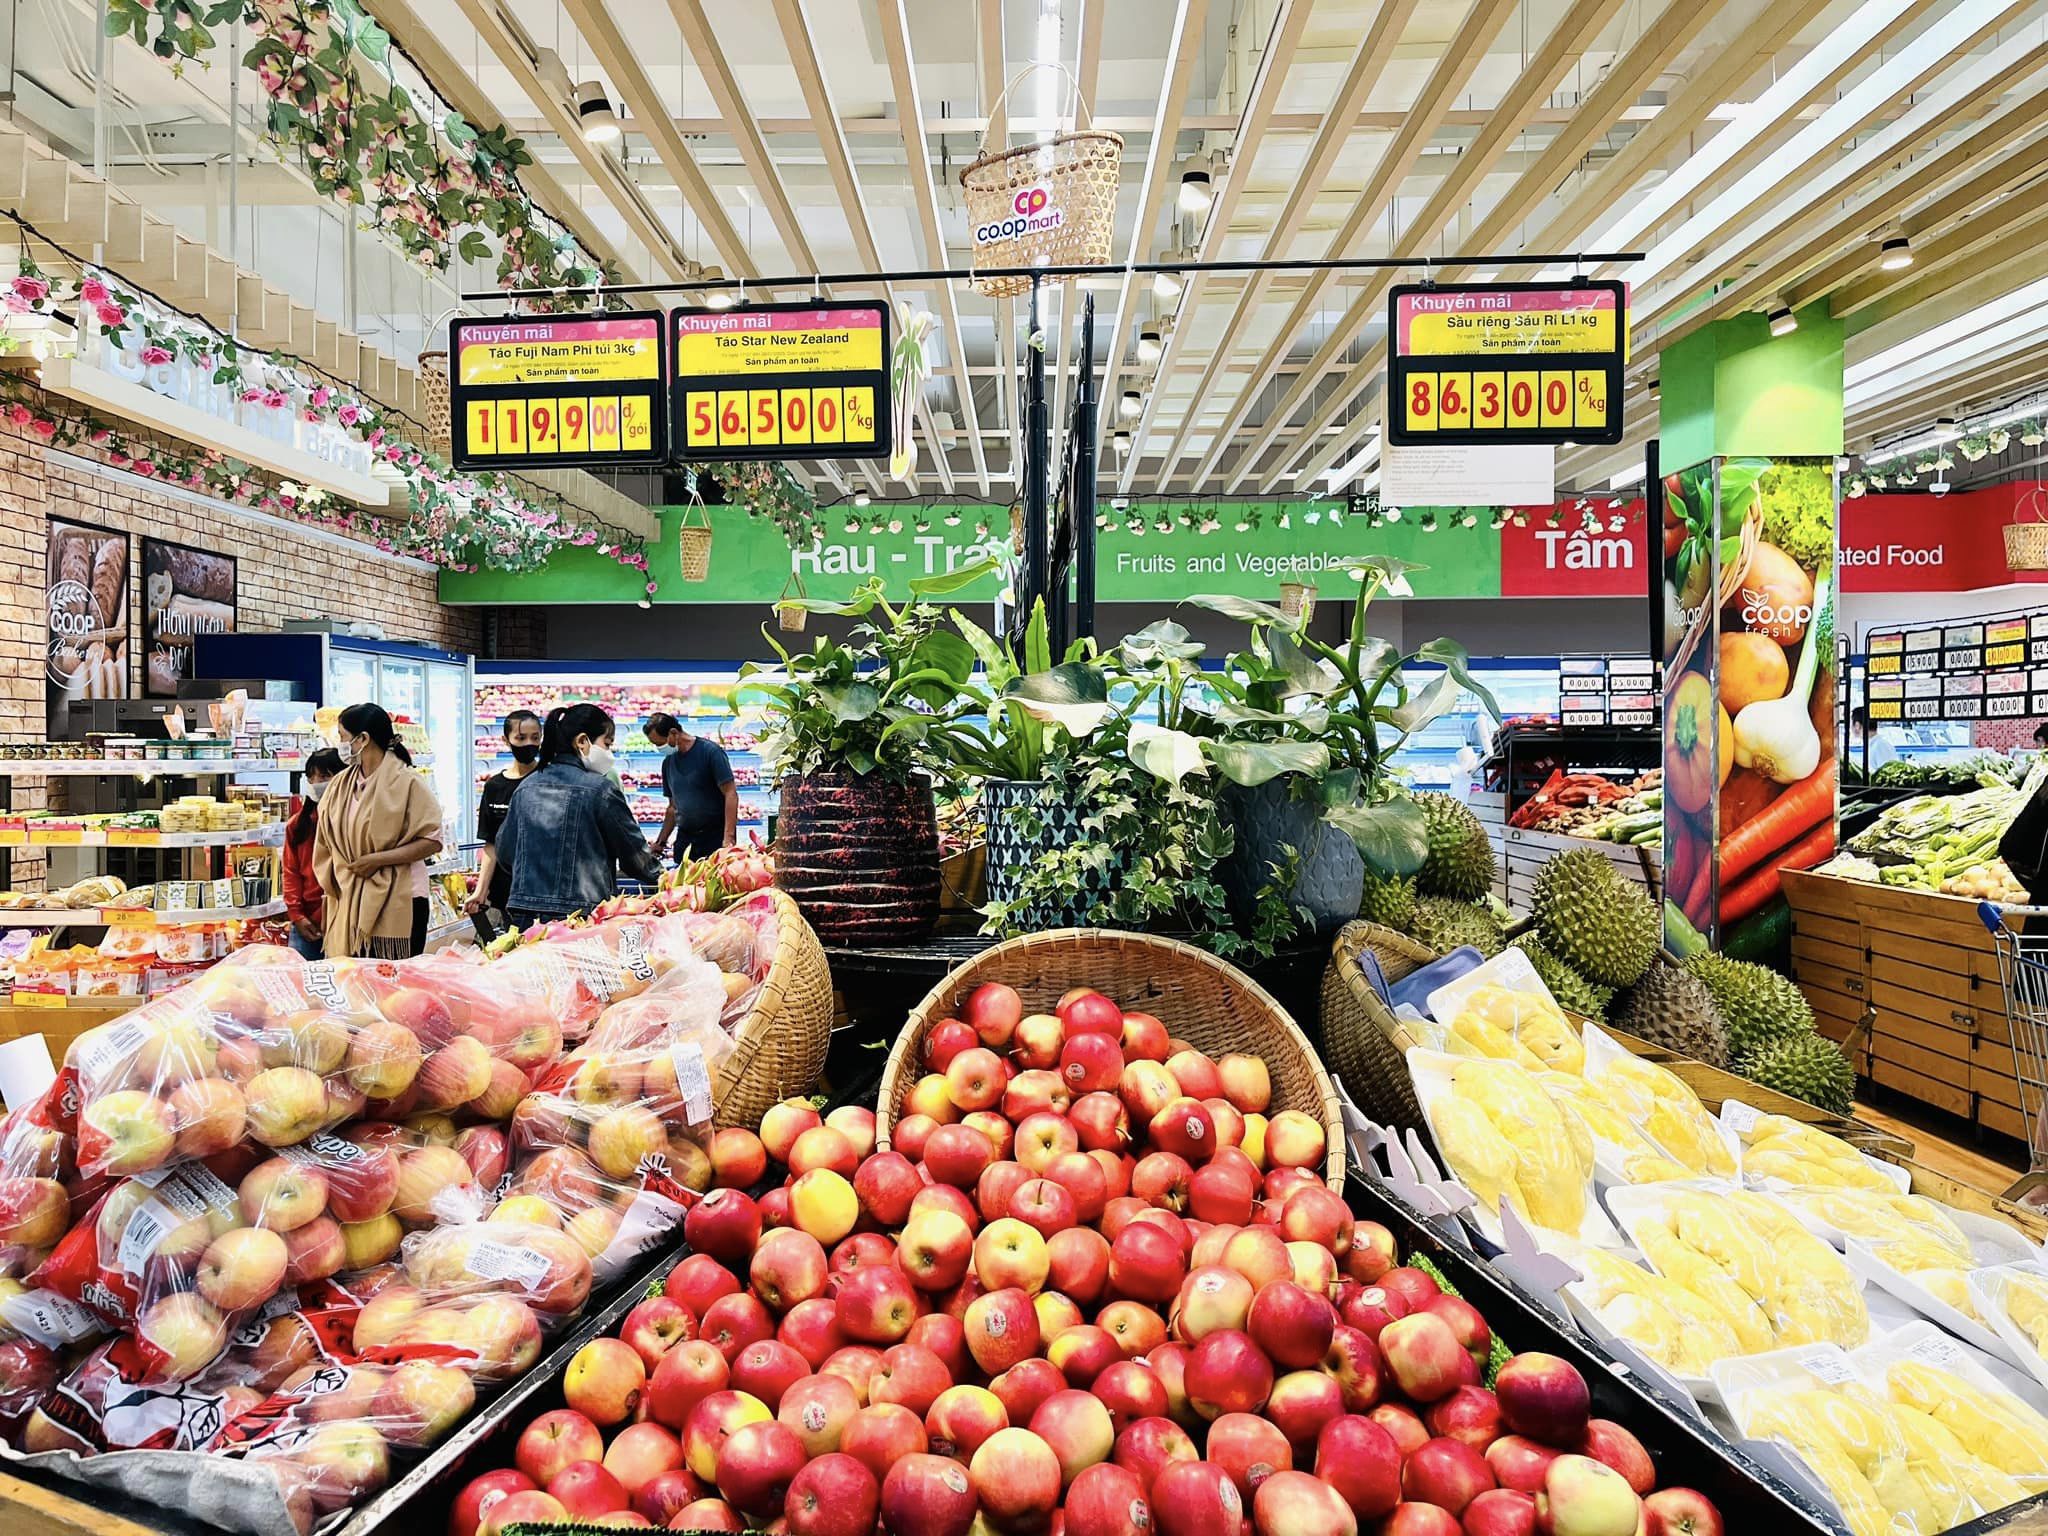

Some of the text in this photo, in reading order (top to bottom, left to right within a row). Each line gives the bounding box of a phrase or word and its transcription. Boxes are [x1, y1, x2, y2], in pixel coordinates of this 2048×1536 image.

[1410, 292, 1512, 312] Khuyến mãi
[679, 313, 772, 333] Khuyến mãi
[1447, 314, 1473, 328] Sầu
[1476, 316, 1511, 329] riêng
[1580, 314, 1598, 328] kg
[460, 324, 553, 344] Khuyến mãi
[715, 333, 849, 348] Táo Star New Zealand
[488, 342, 636, 359] Táo Fuji Nam Phi túi 3kg
[1411, 379, 1567, 418] 86.300
[478, 404, 618, 443] 119.900
[694, 397, 837, 436] 56.500
[791, 537, 875, 574] Rau
[1117, 552, 1176, 574] Fruits
[1186, 552, 1226, 574] and
[1887, 544, 1943, 566] Food
[1745, 625, 1791, 637] fresh
